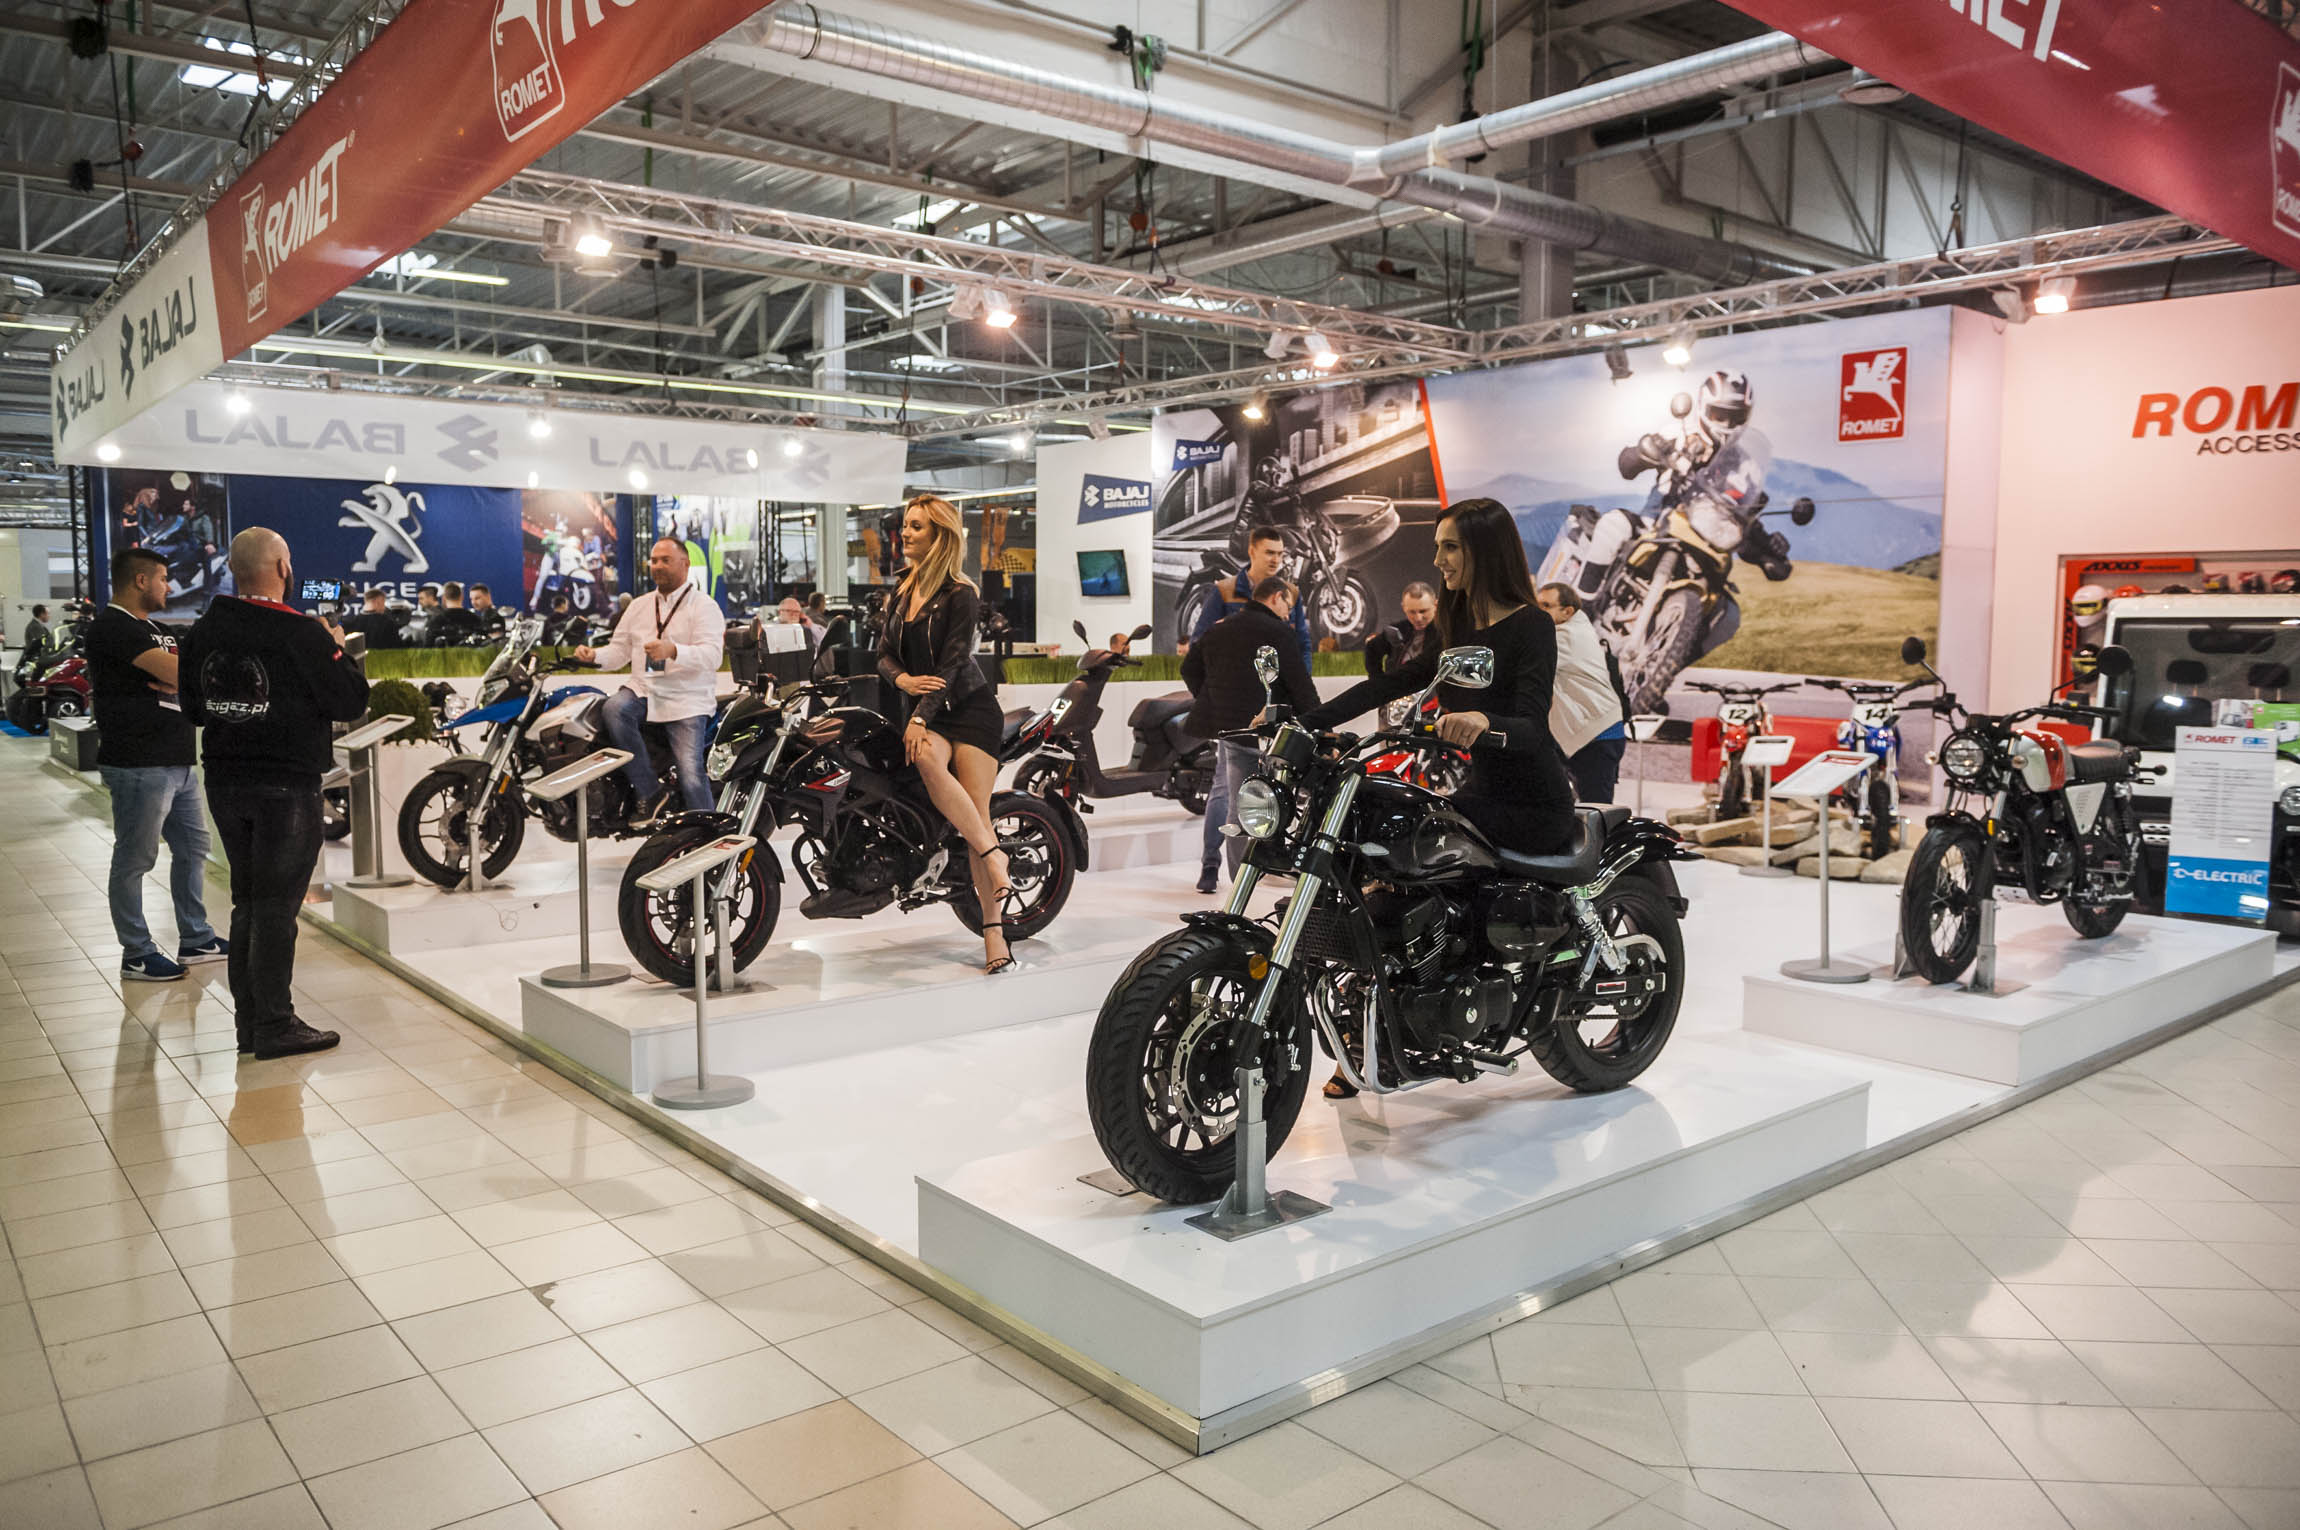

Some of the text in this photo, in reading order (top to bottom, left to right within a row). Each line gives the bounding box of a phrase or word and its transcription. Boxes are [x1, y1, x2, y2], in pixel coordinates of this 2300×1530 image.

[501, 62, 553, 120] ROMET
[264, 137, 348, 274] ROMET
[140, 276, 197, 370] BAJAJ
[68, 358, 106, 420] BAJAJ
[2132, 382, 2300, 438] ROM
[1841, 417, 1901, 436] ROMET
[1190, 445, 1220, 456] BAJAJ
[1104, 485, 1149, 501] BAJAJ
[1727, 708, 1748, 720] 12
[1865, 708, 1888, 720] 14
[2195, 735, 2236, 745] ROMET
